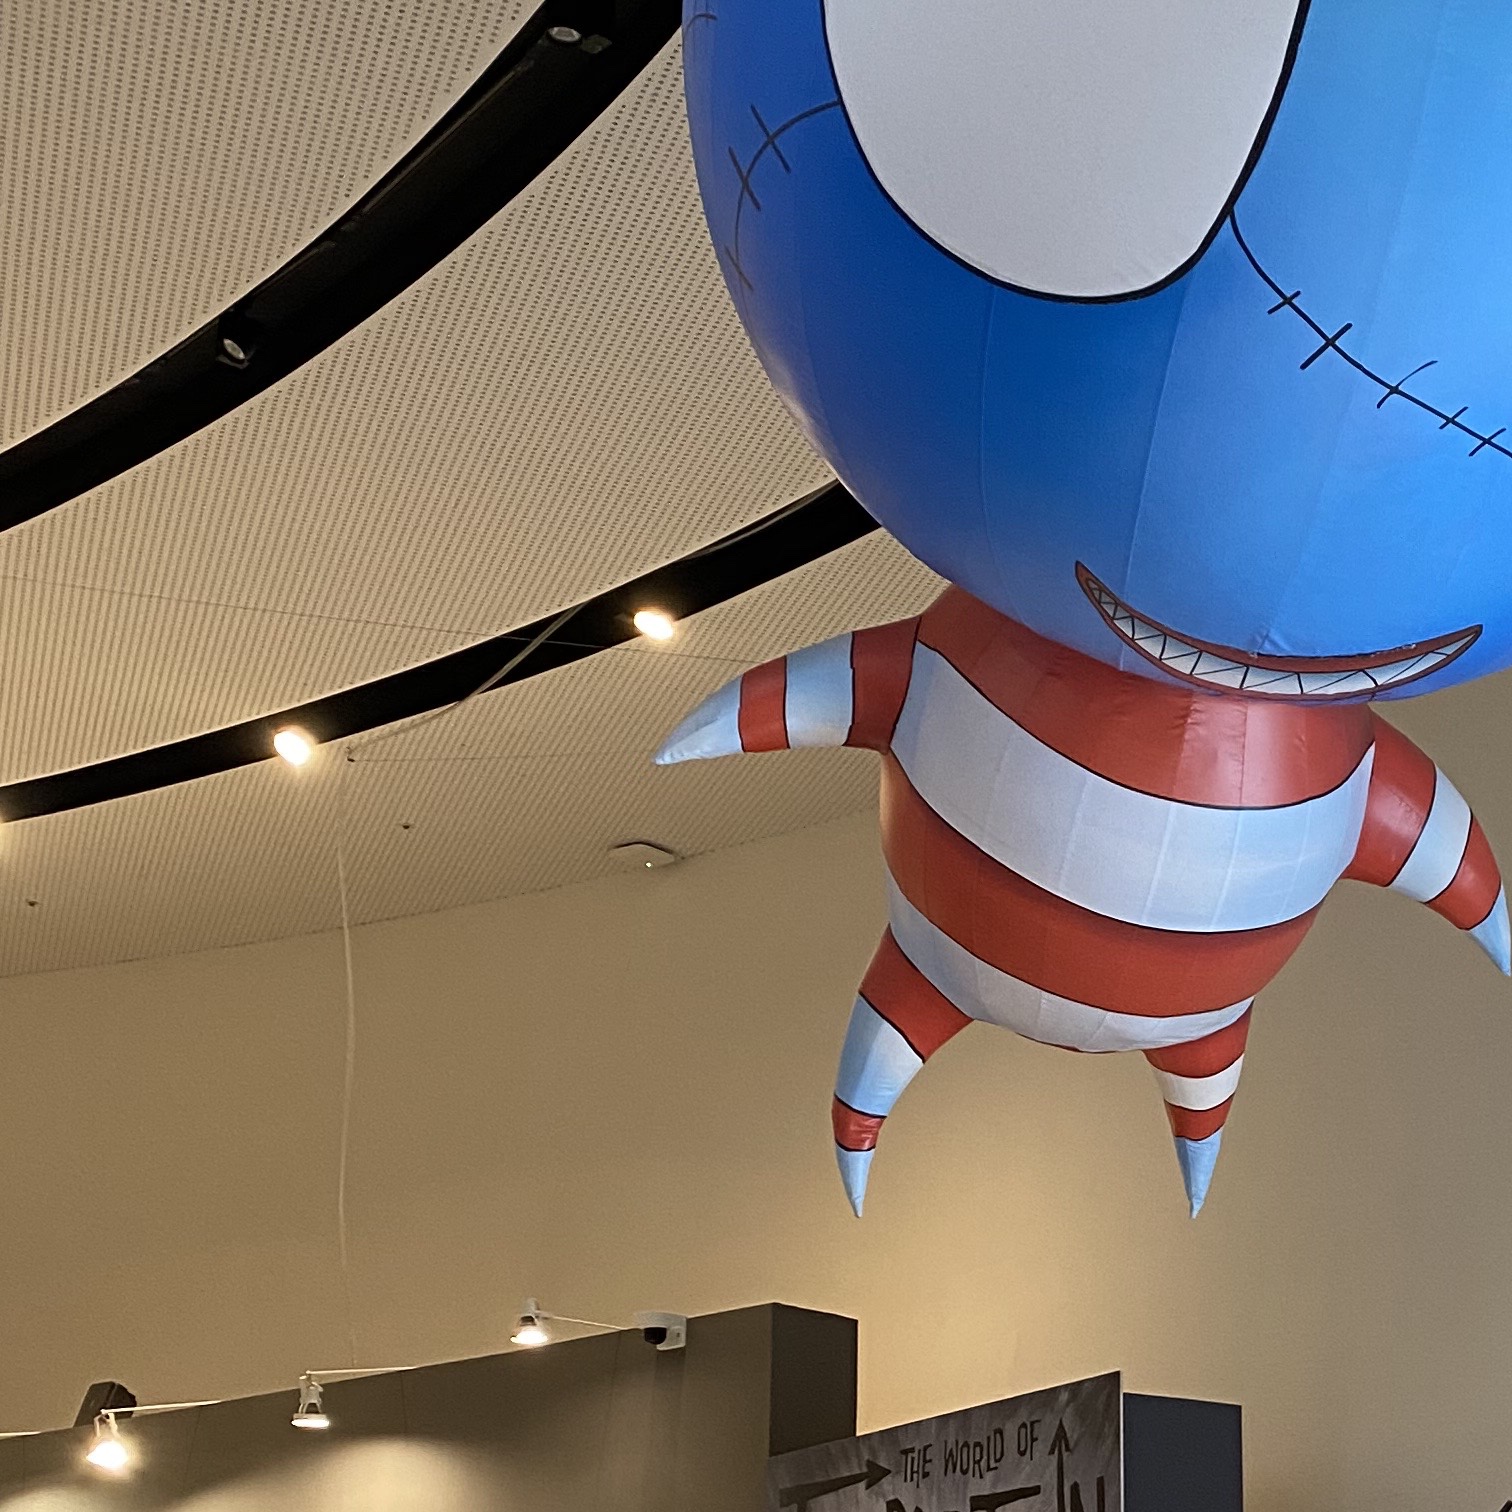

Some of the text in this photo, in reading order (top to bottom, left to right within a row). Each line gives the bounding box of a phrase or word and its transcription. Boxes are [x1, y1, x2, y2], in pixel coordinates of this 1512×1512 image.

[900, 1419, 1042, 1488] THE WORLD OF
